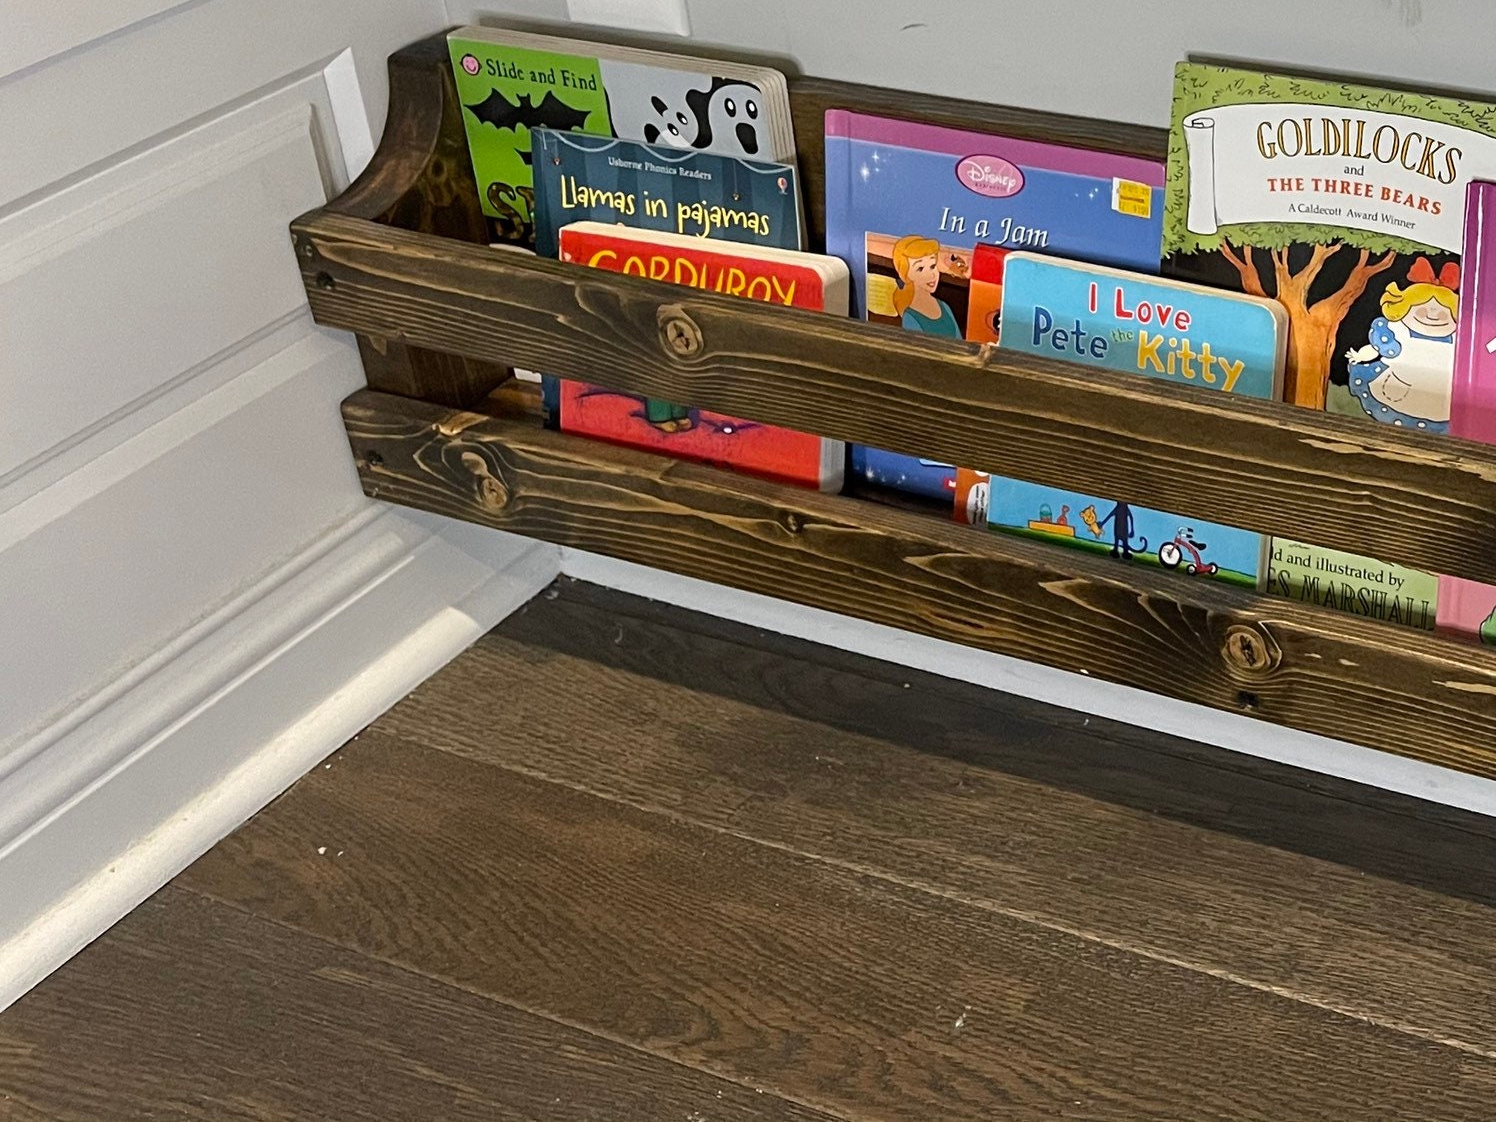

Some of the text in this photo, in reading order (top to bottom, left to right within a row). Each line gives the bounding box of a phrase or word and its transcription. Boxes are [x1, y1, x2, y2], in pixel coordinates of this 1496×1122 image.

[486, 59, 597, 91] Slide and Find
[608, 157, 712, 180] Usborne Phonics Readers
[1257, 118, 1462, 184] GOLDILOCKS
[1344, 165, 1364, 176] and
[560, 175, 635, 215] Llamas
[644, 190, 667, 218] in
[678, 201, 769, 238] pajamas
[1267, 178, 1441, 215] THE THREE BEARS
[938, 207, 1050, 247] In a Jam
[1288, 203, 1416, 229] A Caldecott Award Winner
[1089, 282, 1192, 331] I Love
[1032, 305, 1245, 391] Pete the Kitty
[1287, 555, 1312, 568] and
[1316, 557, 1384, 583] illustrated
[1388, 572, 1405, 591] by
